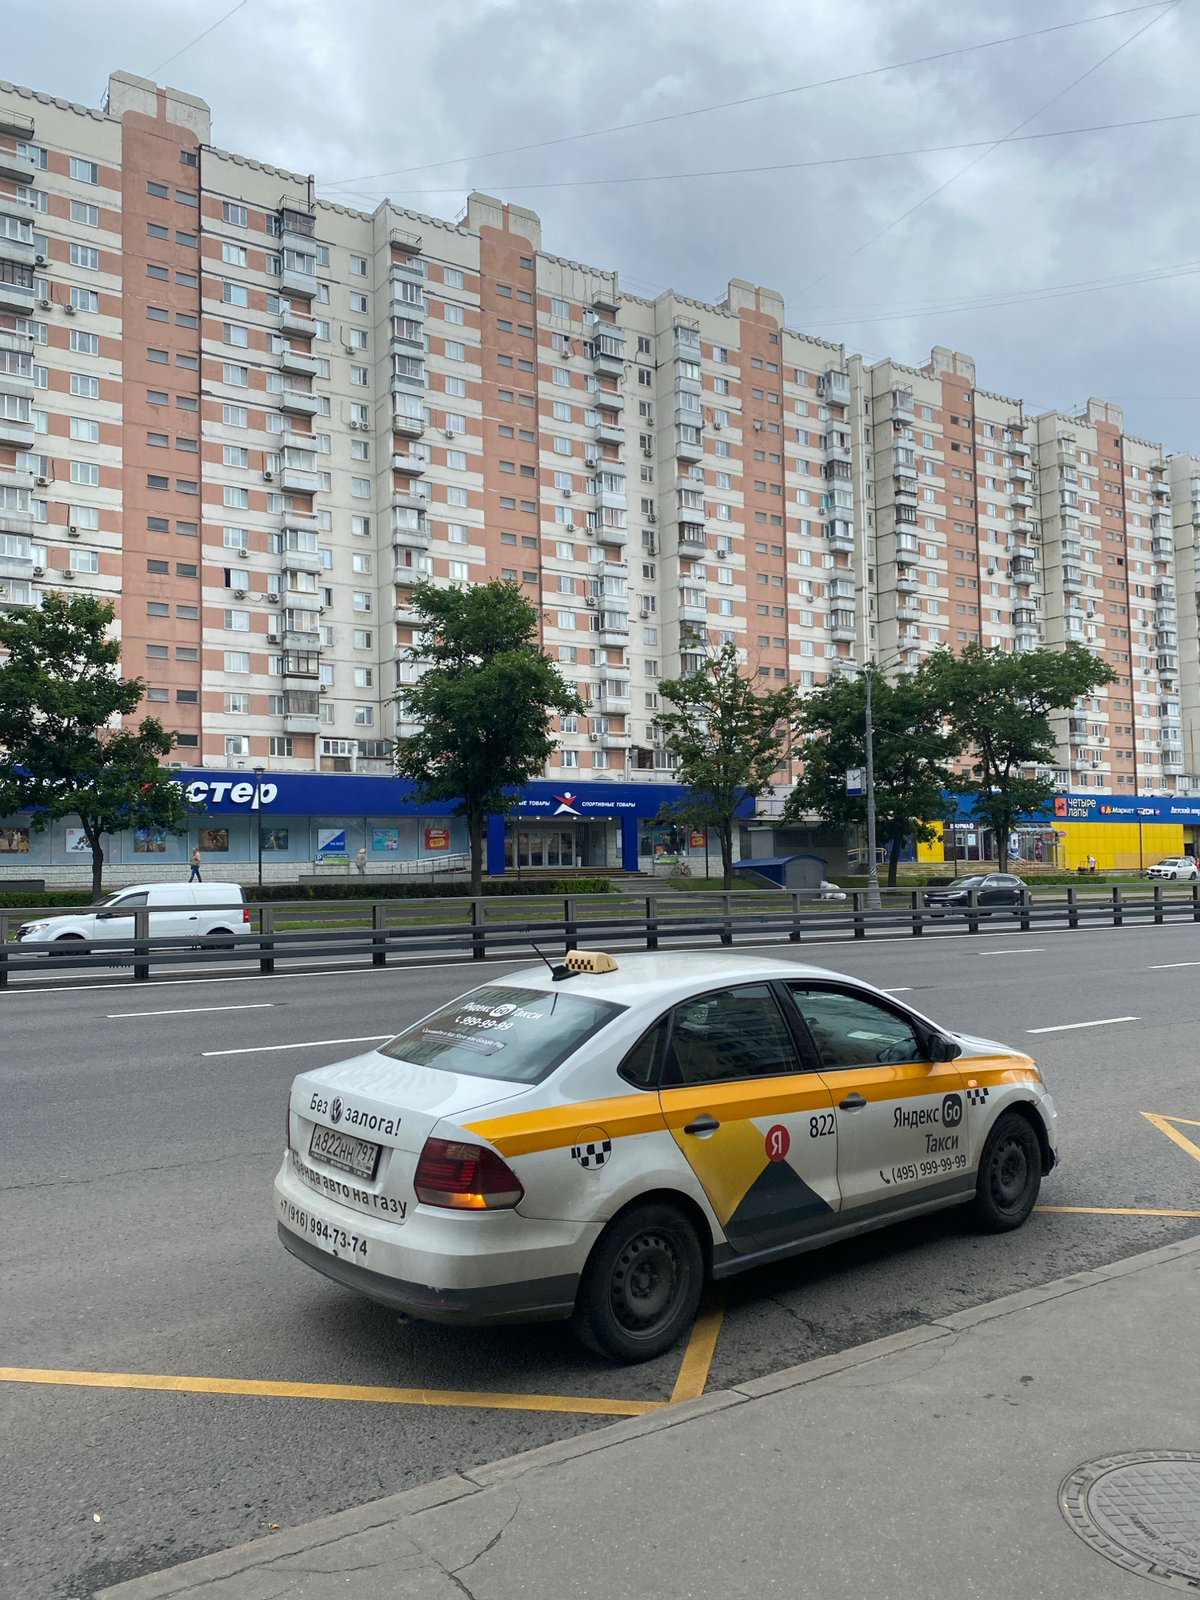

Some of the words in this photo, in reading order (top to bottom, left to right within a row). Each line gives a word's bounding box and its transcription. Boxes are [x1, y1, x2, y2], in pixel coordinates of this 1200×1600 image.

[1112, 806, 1135, 816] Маркет
[511, 1007, 544, 1020] Такси
[310, 1093, 329, 1114] Без
[344, 1107, 402, 1137] залога!
[809, 1113, 835, 1139] 822
[893, 1106, 940, 1130] Яндекс
[944, 1101, 961, 1121] Go
[771, 1130, 783, 1156] Я
[925, 1133, 959, 1155] Такси
[891, 1163, 919, 1185] (495)
[919, 1154, 967, 1177] 999-99-99
[323, 1175, 350, 1198] авто
[352, 1187, 369, 1206] на
[373, 1194, 408, 1219] газу
[288, 1203, 308, 1233] (916)
[310, 1217, 368, 1256] 994-73-74
